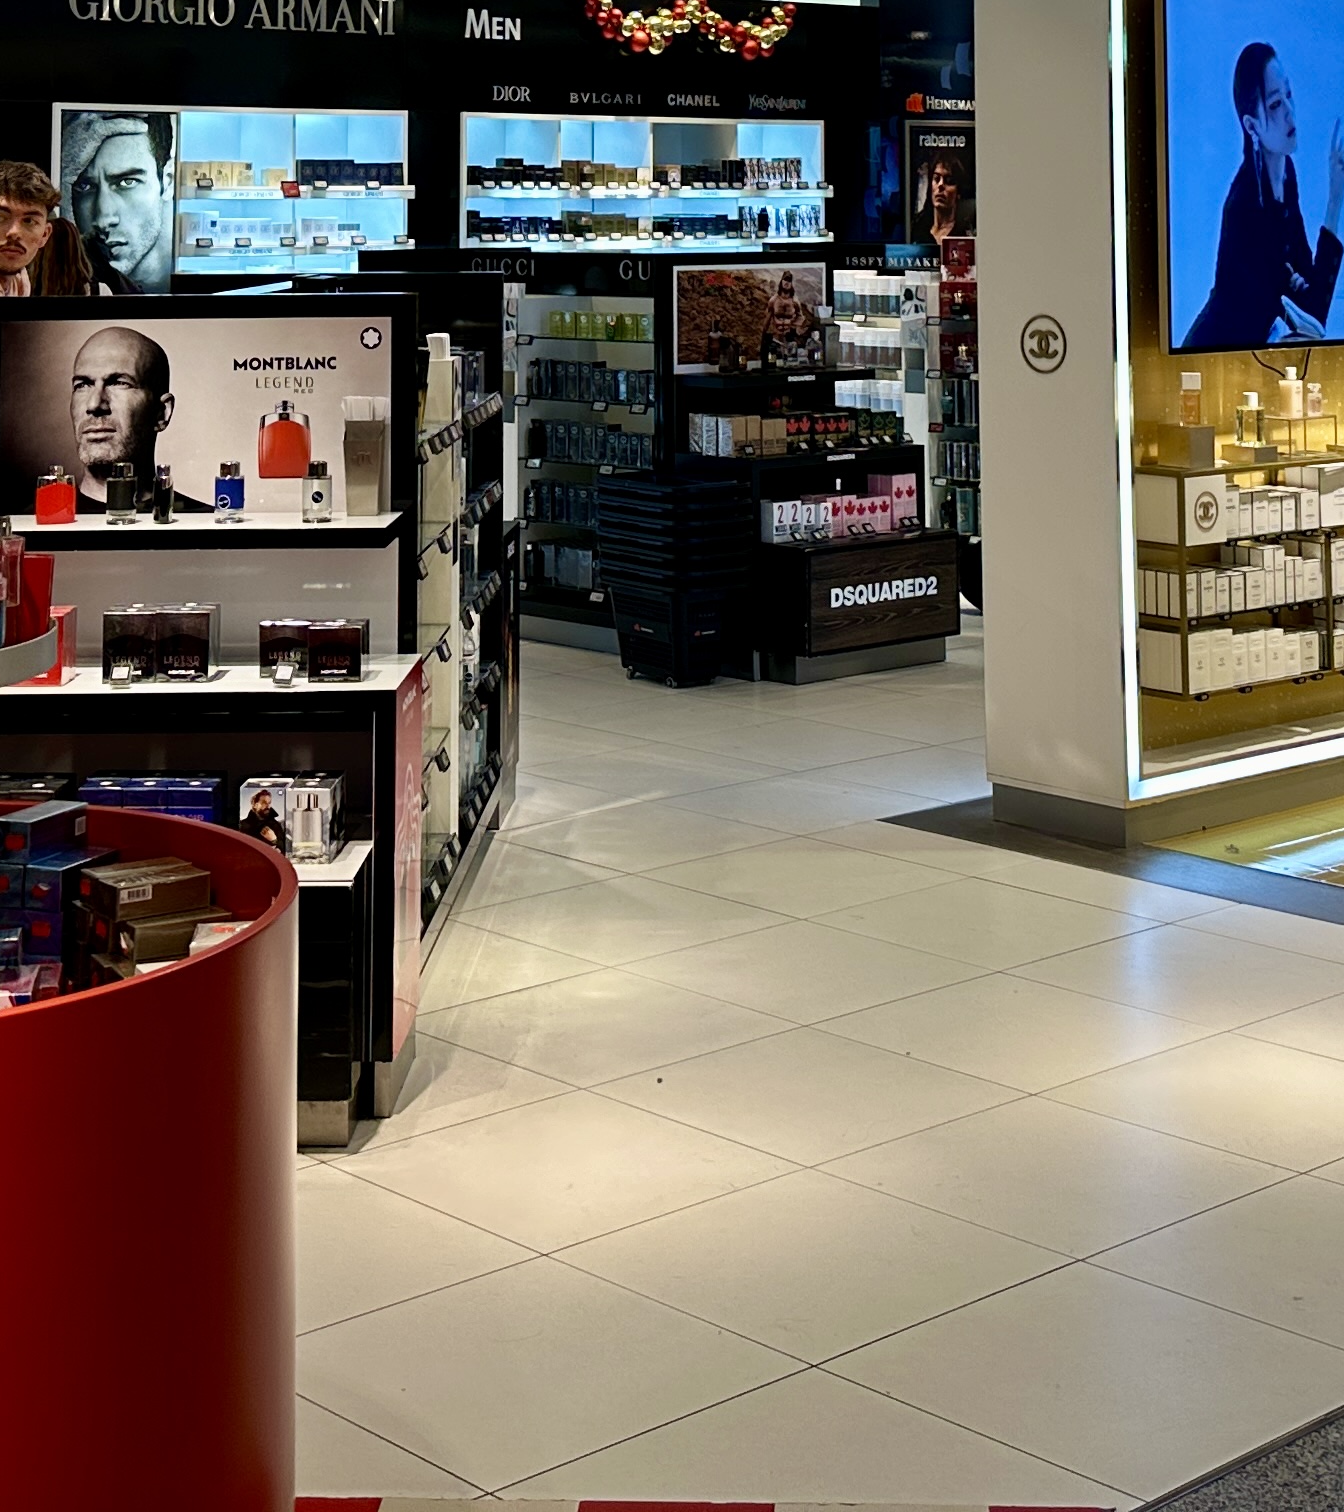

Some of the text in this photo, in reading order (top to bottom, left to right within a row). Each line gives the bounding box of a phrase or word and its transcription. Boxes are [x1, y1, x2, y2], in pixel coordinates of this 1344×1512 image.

[492, 85, 532, 103] DIOR
[569, 92, 642, 105] BVLGARI
[667, 93, 721, 107] CHANEL
[919, 133, 966, 148] rabanne
[471, 258, 536, 277] GUCCI
[888, 257, 941, 268] MIYAKE
[233, 356, 337, 370] MONTBLANC
[255, 376, 314, 388] LEGEND
[830, 576, 938, 608] DSQUARED2
